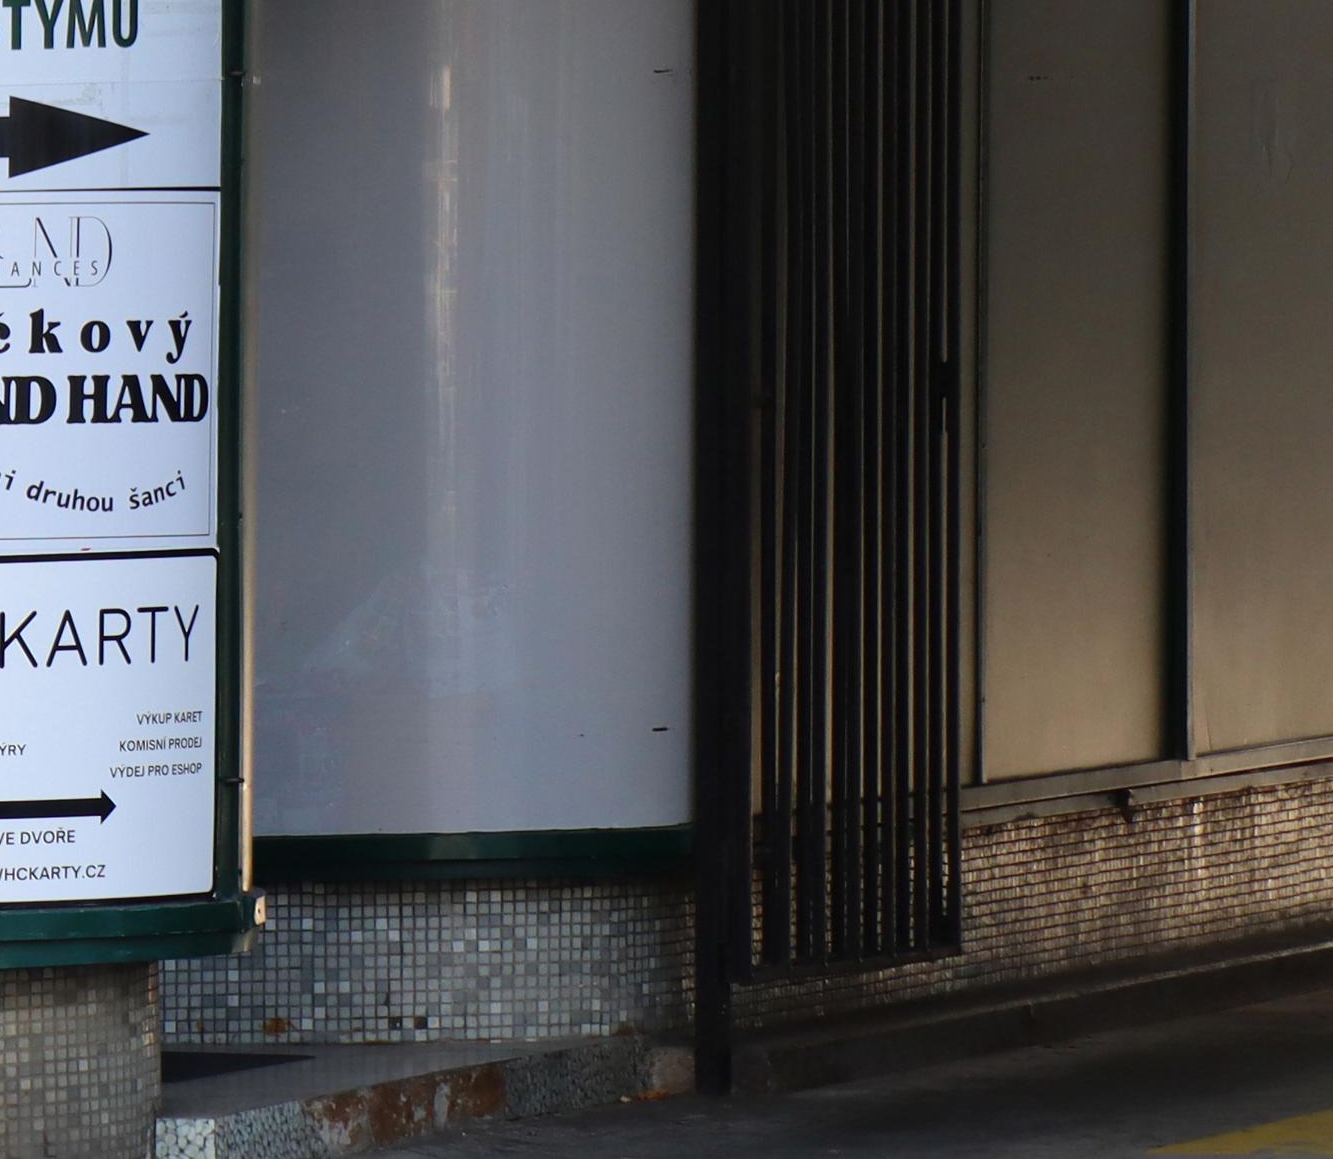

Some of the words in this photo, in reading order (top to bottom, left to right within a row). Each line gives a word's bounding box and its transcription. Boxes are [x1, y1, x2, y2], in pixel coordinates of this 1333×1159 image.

[66, 373, 209, 424] HAND
[26, 481, 114, 512] druhou
[129, 470, 185, 510] šanci
[136, 711, 172, 725] VÝKUP
[174, 710, 203, 724] KARET
[119, 736, 166, 752] KOMISNÍ
[168, 737, 203, 751] PRODEJ
[110, 763, 145, 778] VÝDEJ
[148, 764, 169, 777] PRO
[171, 762, 203, 775] ESHOP
[20, 827, 76, 844] DVOŘE
